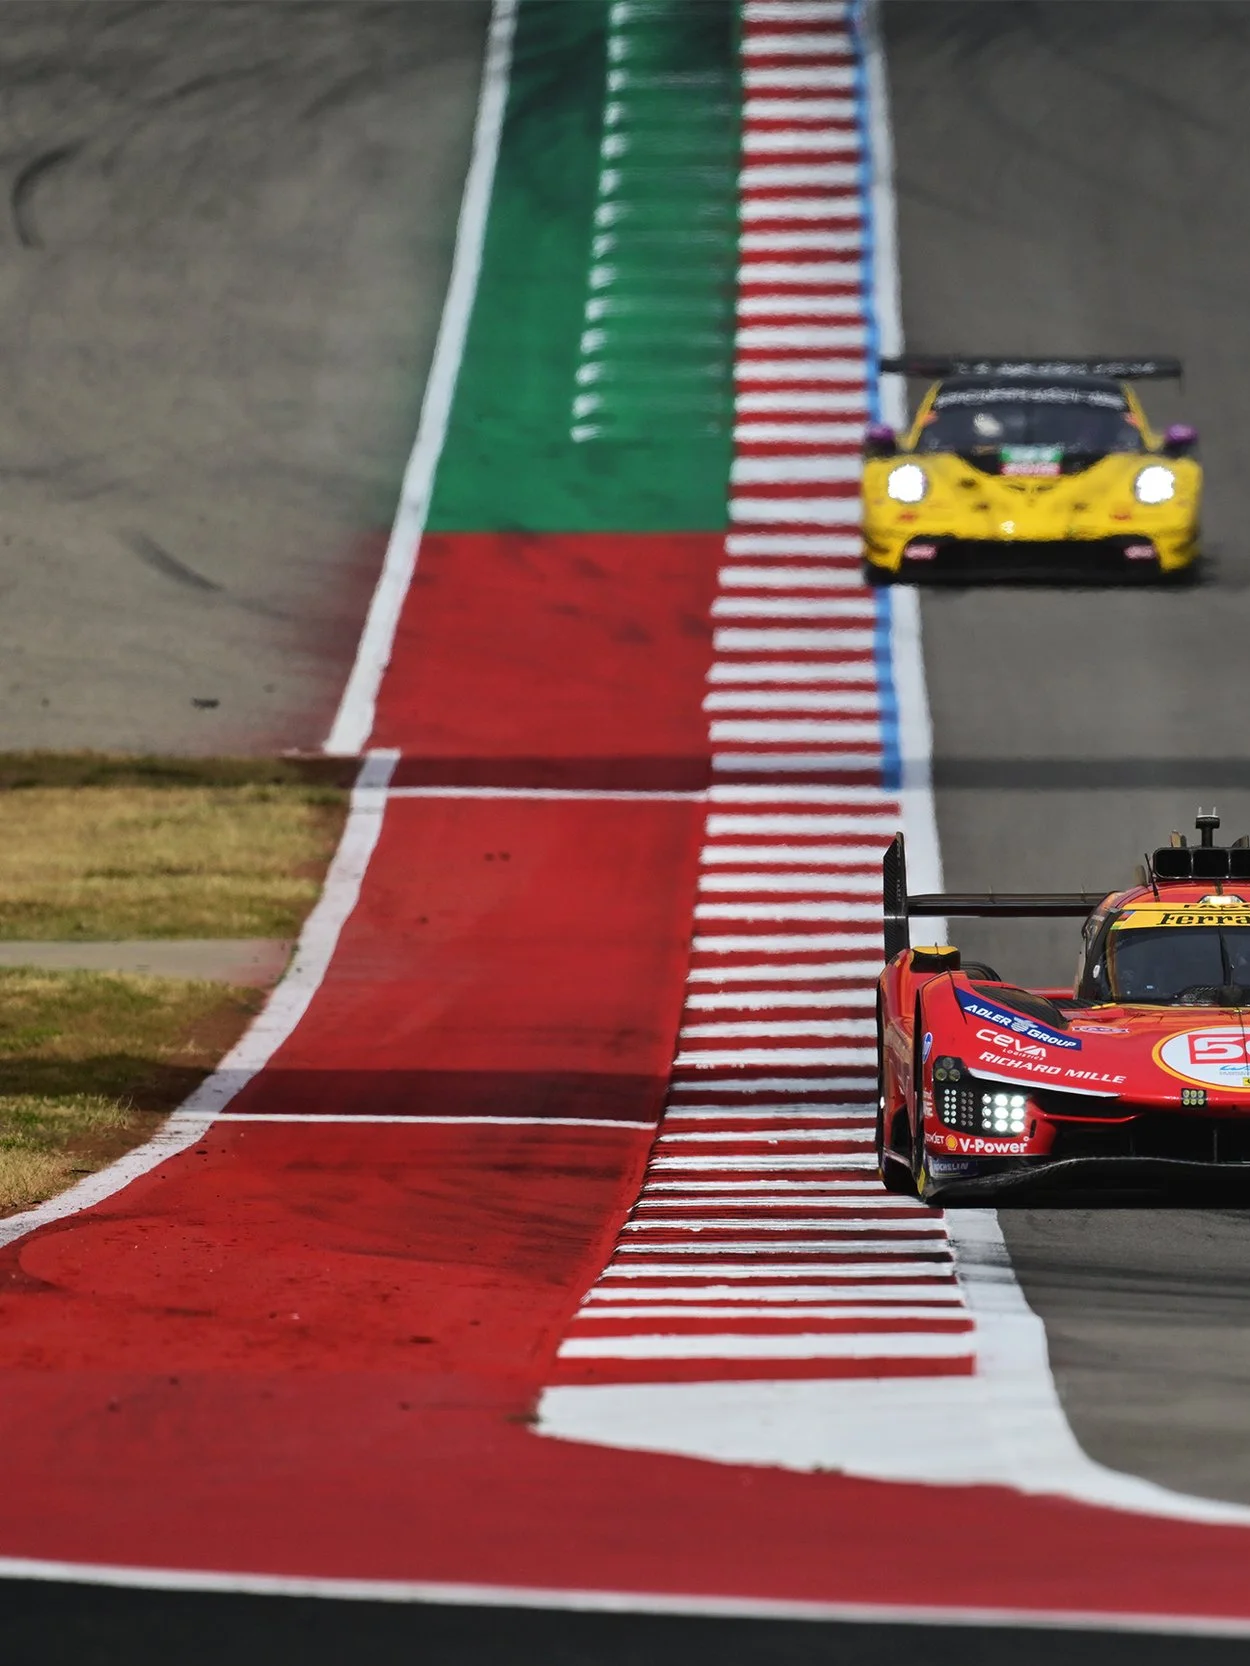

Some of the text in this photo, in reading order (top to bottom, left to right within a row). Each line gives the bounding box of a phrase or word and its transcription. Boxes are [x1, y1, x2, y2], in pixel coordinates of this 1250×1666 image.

[964, 1004, 1077, 1048] ADLER GROUP
[979, 1051, 1127, 1084] RICHARD MILLE
[959, 1138, 1028, 1154] V-Power
